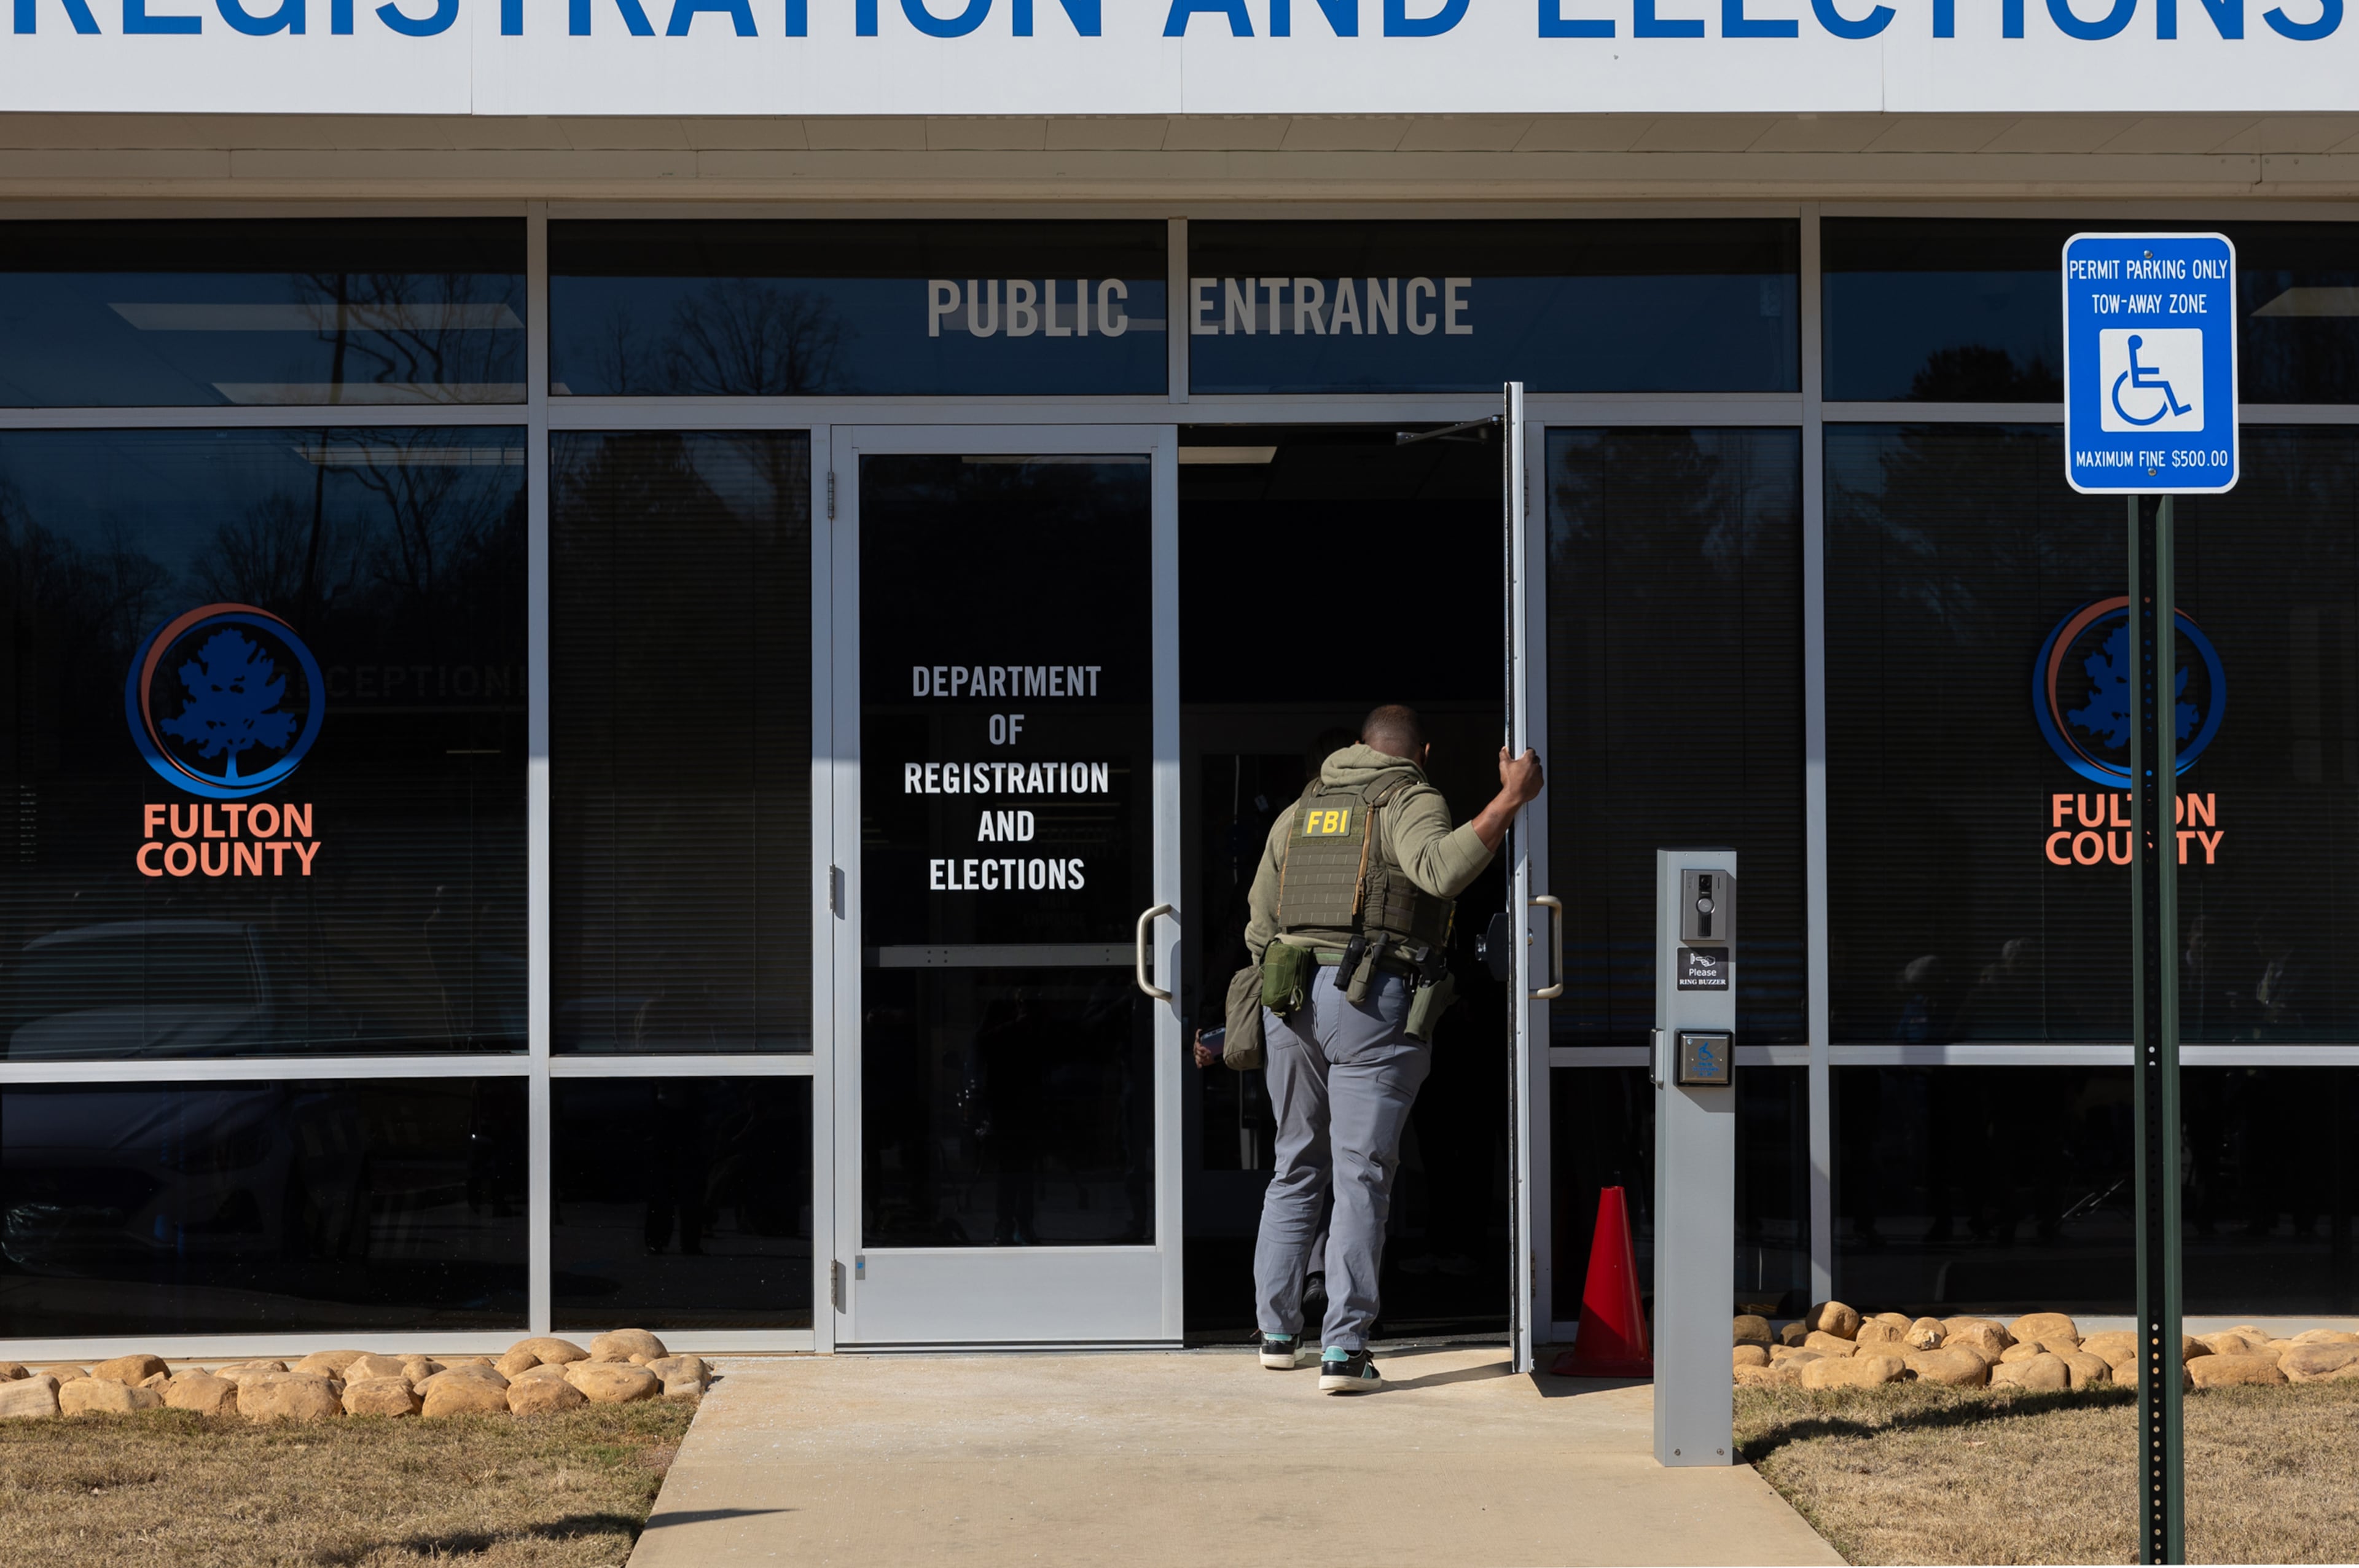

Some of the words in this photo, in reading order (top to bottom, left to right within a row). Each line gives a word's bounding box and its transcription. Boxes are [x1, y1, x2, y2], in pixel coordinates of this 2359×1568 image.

[2070, 260, 2120, 279] PERMIT
[2127, 259, 2186, 279] PARKING
[2193, 259, 2228, 279] ONLY
[928, 278, 1129, 337] PUBLIC
[1191, 276, 1473, 336] ENTRANCE
[2092, 294, 2162, 314] TOW-AWAY
[2169, 294, 2207, 314] ZONE
[2076, 451, 2133, 467] MAXIMUM
[2139, 451, 2165, 467] FINE
[2172, 450, 2228, 468] $500.00
[912, 666, 1101, 696] DEPARTMENT
[989, 714, 1025, 745] OF
[904, 762, 1109, 794] REGISTRATION
[144, 803, 313, 838] FULTON
[977, 810, 1035, 841] AND
[1307, 809, 1348, 833] FBI
[2052, 793, 2216, 828] FULN
[136, 841, 321, 877] COUNTY
[2045, 830, 2224, 865] COUTY
[929, 858, 1086, 891] ELECTIONS
[1688, 968, 1717, 977] Please
